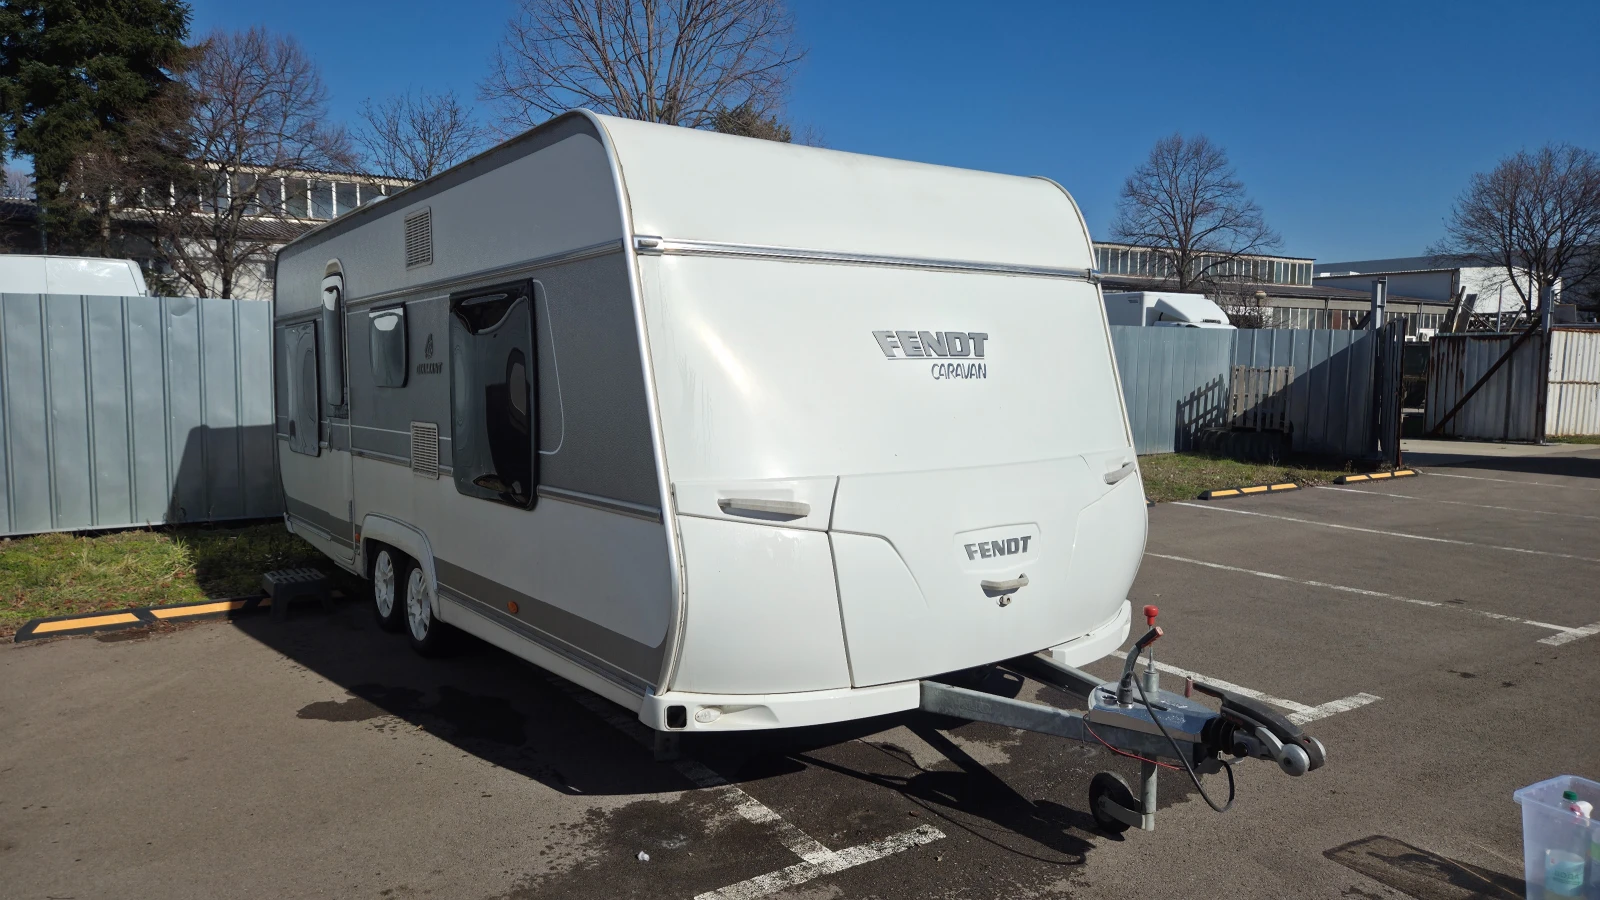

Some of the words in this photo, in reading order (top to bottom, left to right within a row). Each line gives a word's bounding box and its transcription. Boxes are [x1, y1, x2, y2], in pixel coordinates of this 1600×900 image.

[872, 331, 988, 357] FENDT
[931, 363, 987, 380] CARAVAN
[964, 536, 1031, 561] FENDT
